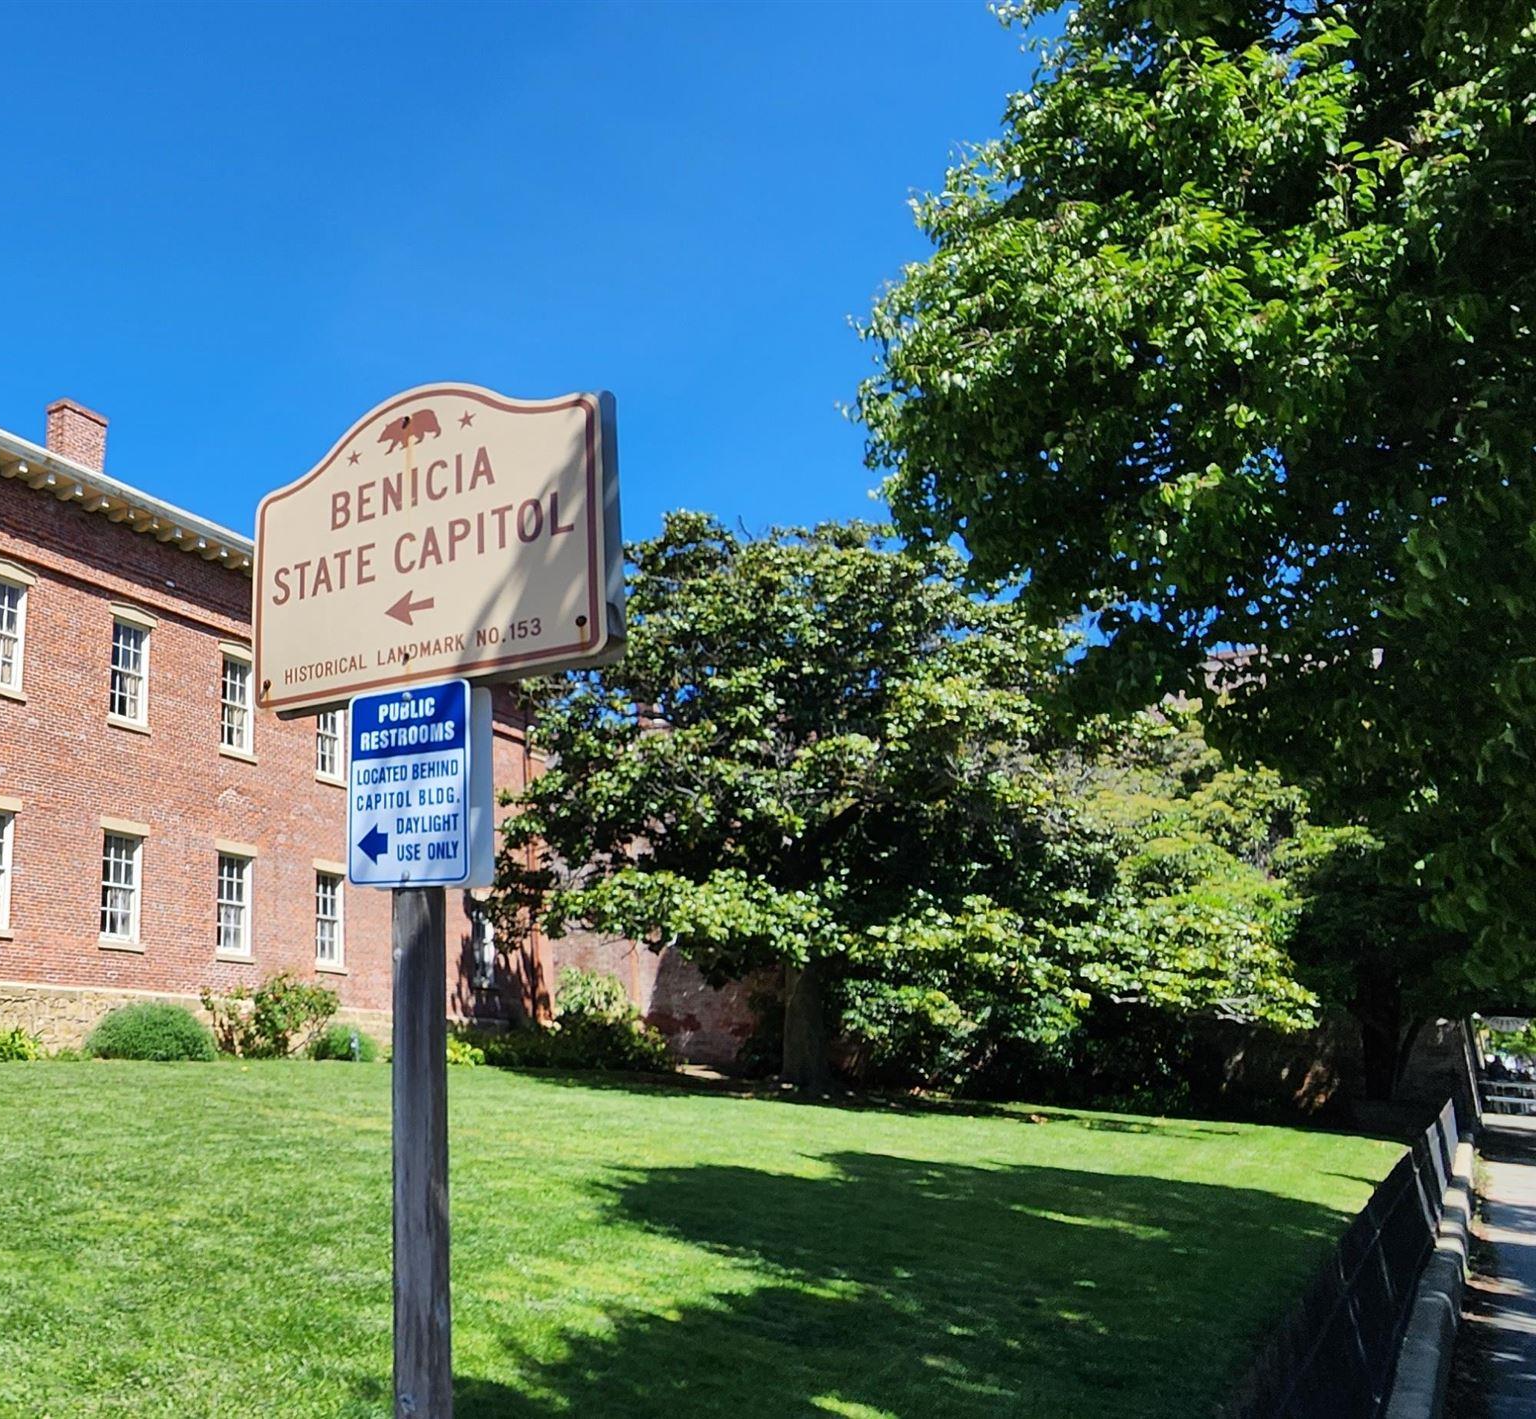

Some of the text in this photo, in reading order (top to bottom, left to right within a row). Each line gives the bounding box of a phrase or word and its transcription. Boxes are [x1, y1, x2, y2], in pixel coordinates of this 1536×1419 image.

[330, 445, 495, 531] BENICIA
[272, 491, 574, 606] STATE CAPITOL
[284, 653, 368, 685] HISTORICAL
[376, 634, 465, 666] LANDMARK
[378, 696, 436, 724] PUBLIC
[360, 720, 455, 751] RESTROOMS
[357, 759, 459, 786] LOCATED BEHIND
[356, 786, 461, 812] CAPITOL BLDG.
[396, 812, 459, 835] DAYLIGHT
[396, 840, 459, 862] USE ONLY
